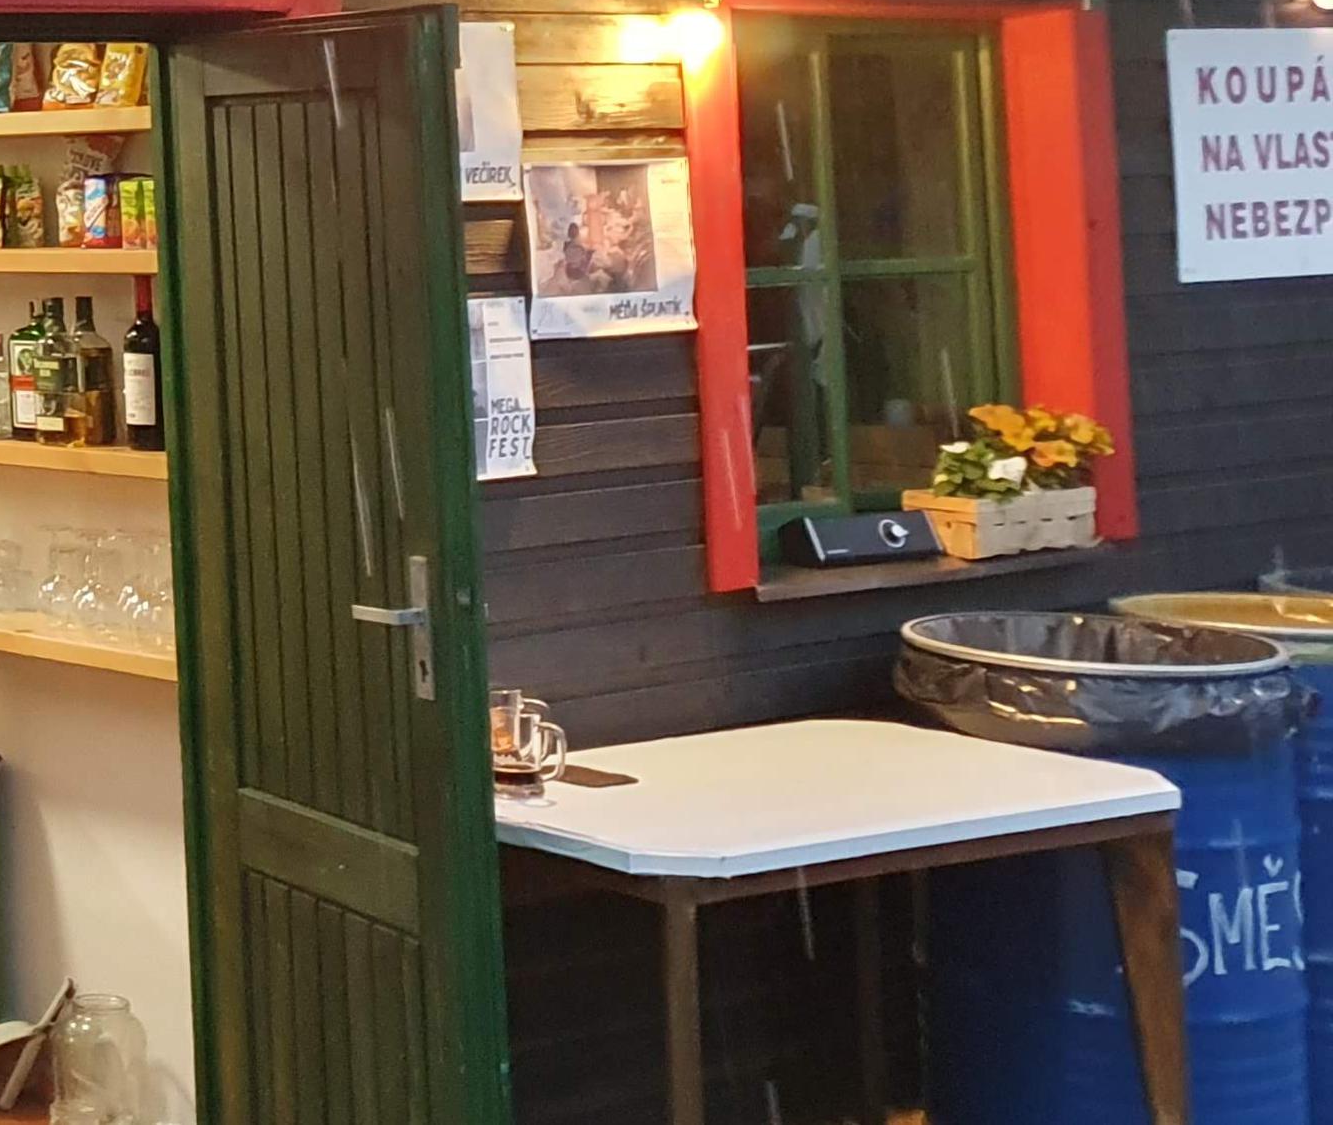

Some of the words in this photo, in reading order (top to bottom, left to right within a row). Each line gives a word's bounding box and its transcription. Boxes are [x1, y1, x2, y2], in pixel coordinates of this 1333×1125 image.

[1196, 55, 1331, 105] KOUPÁ
[1200, 135, 1245, 172] NA
[1254, 132, 1333, 171] VLAS
[490, 398, 521, 415] MEGA
[490, 414, 532, 436] ROCK
[488, 436, 532, 459] FEST
